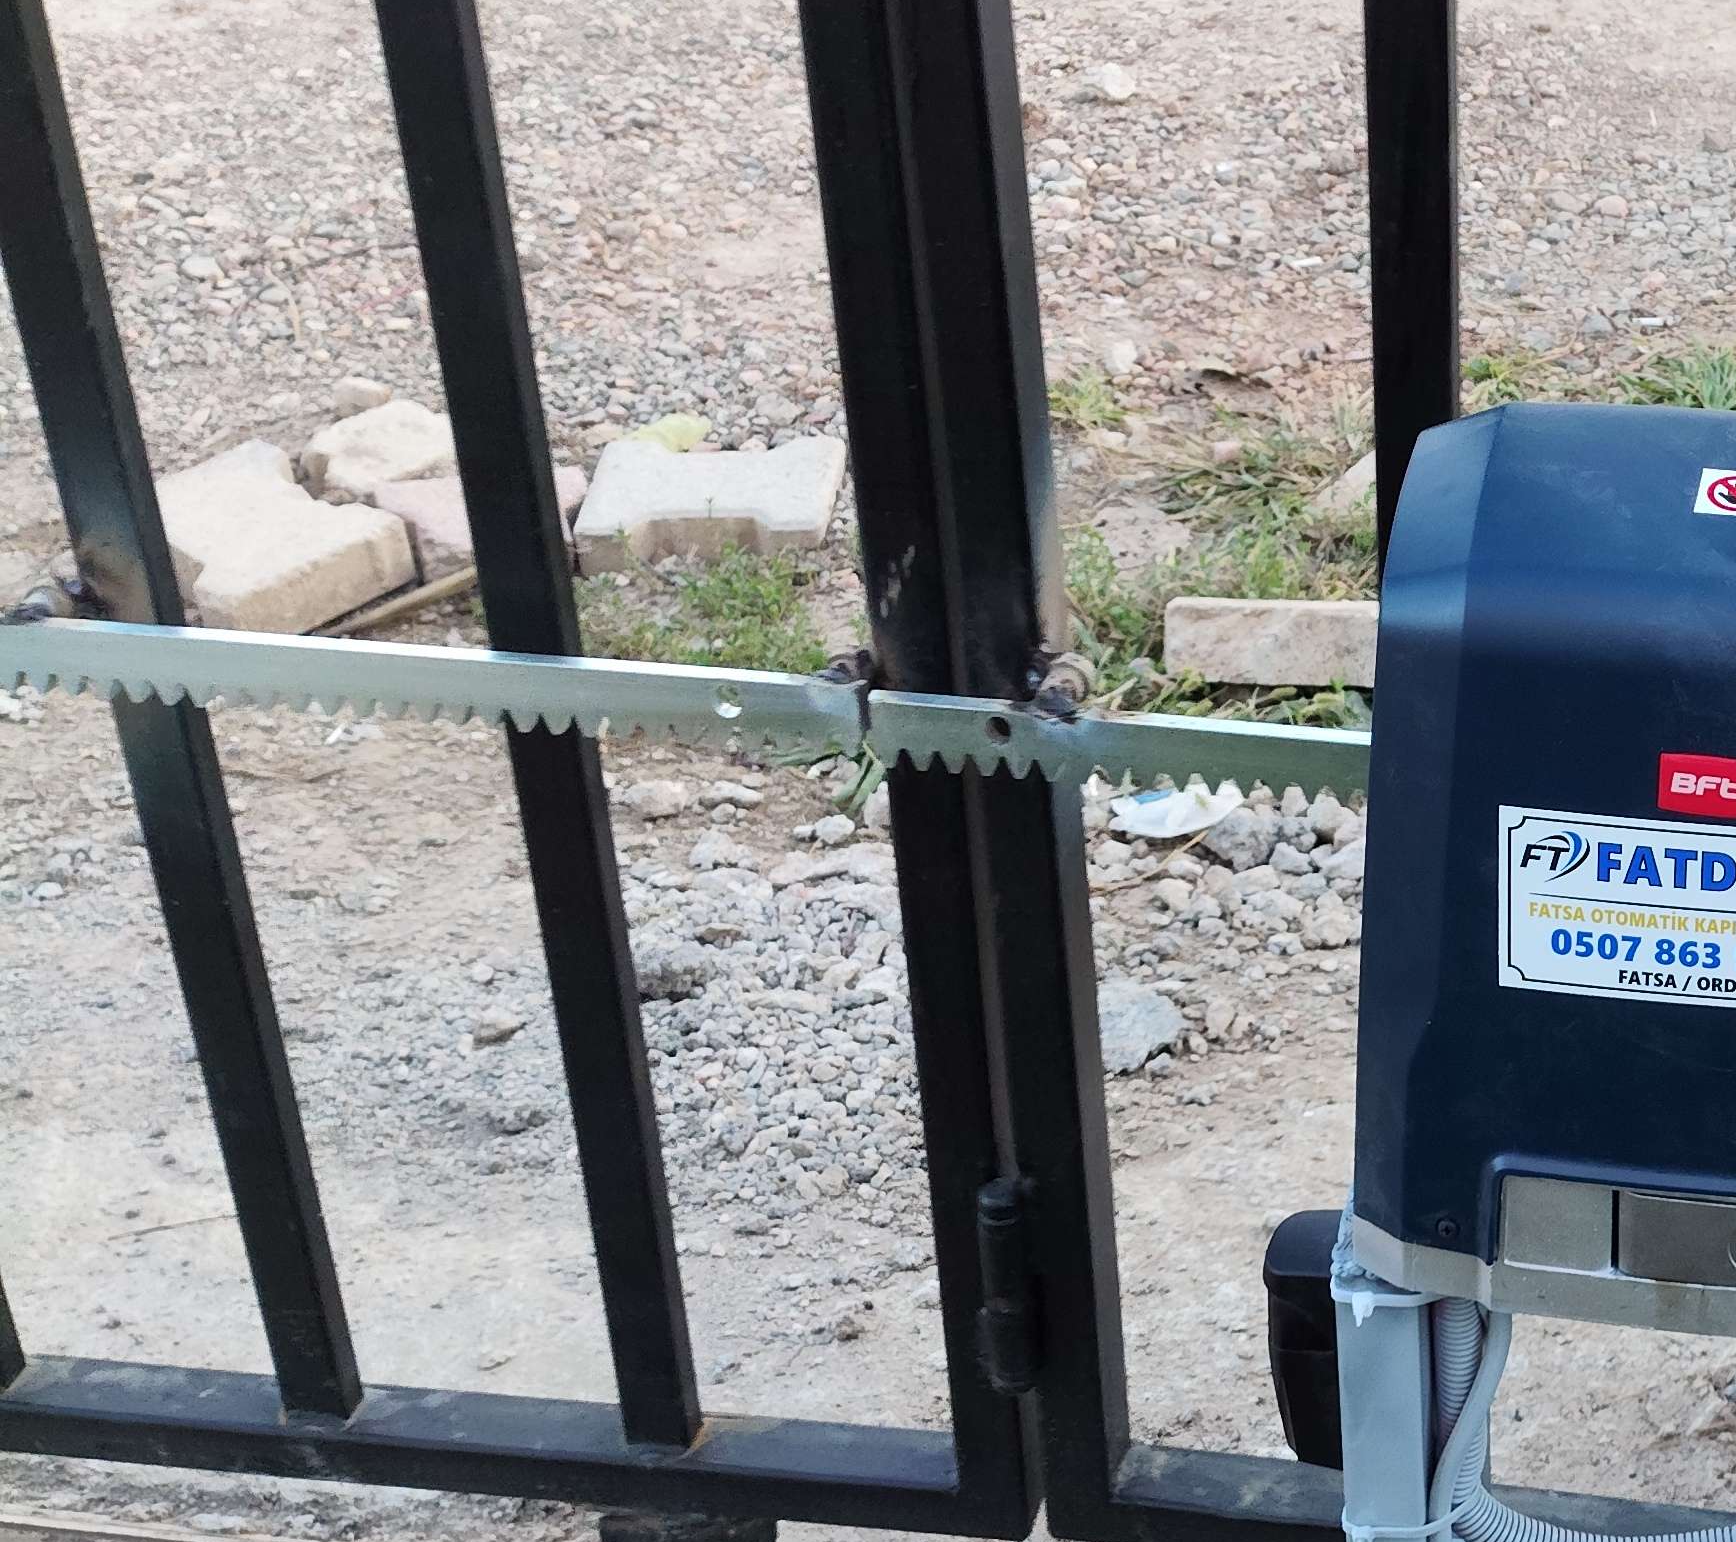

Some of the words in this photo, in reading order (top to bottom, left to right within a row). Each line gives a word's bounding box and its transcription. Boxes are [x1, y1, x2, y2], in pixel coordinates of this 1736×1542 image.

[1528, 901, 1585, 923] FATSA
[1591, 907, 1690, 932] OTOMATİK
[1694, 917, 1736, 936] KAPI
[1550, 928, 1642, 962] 0507
[1654, 939, 1722, 970] 863
[1618, 969, 1678, 991] FATSA
[1681, 975, 1692, 992] /
